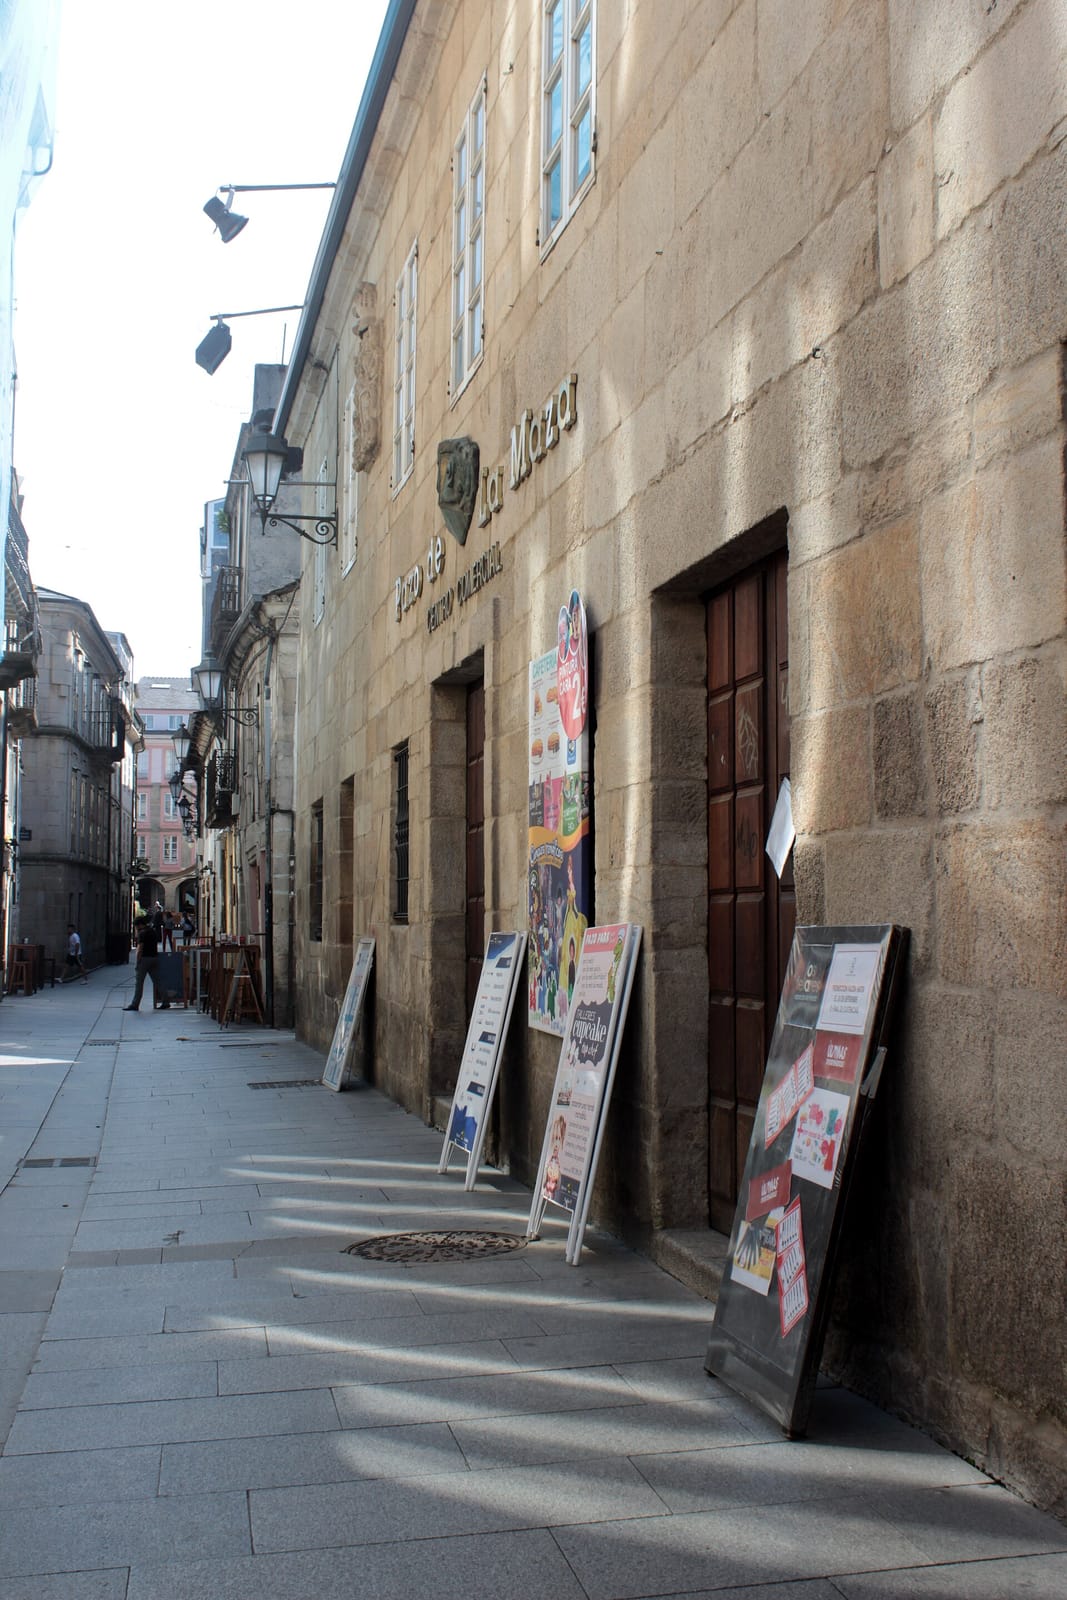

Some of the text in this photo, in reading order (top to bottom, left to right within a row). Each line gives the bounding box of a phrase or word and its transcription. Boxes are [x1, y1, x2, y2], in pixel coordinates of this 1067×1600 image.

[427, 535, 446, 584] de
[509, 373, 578, 490] Maza
[427, 541, 504, 633] CENTRO COMERCIAL
[573, 1017, 607, 1044] cupcake
